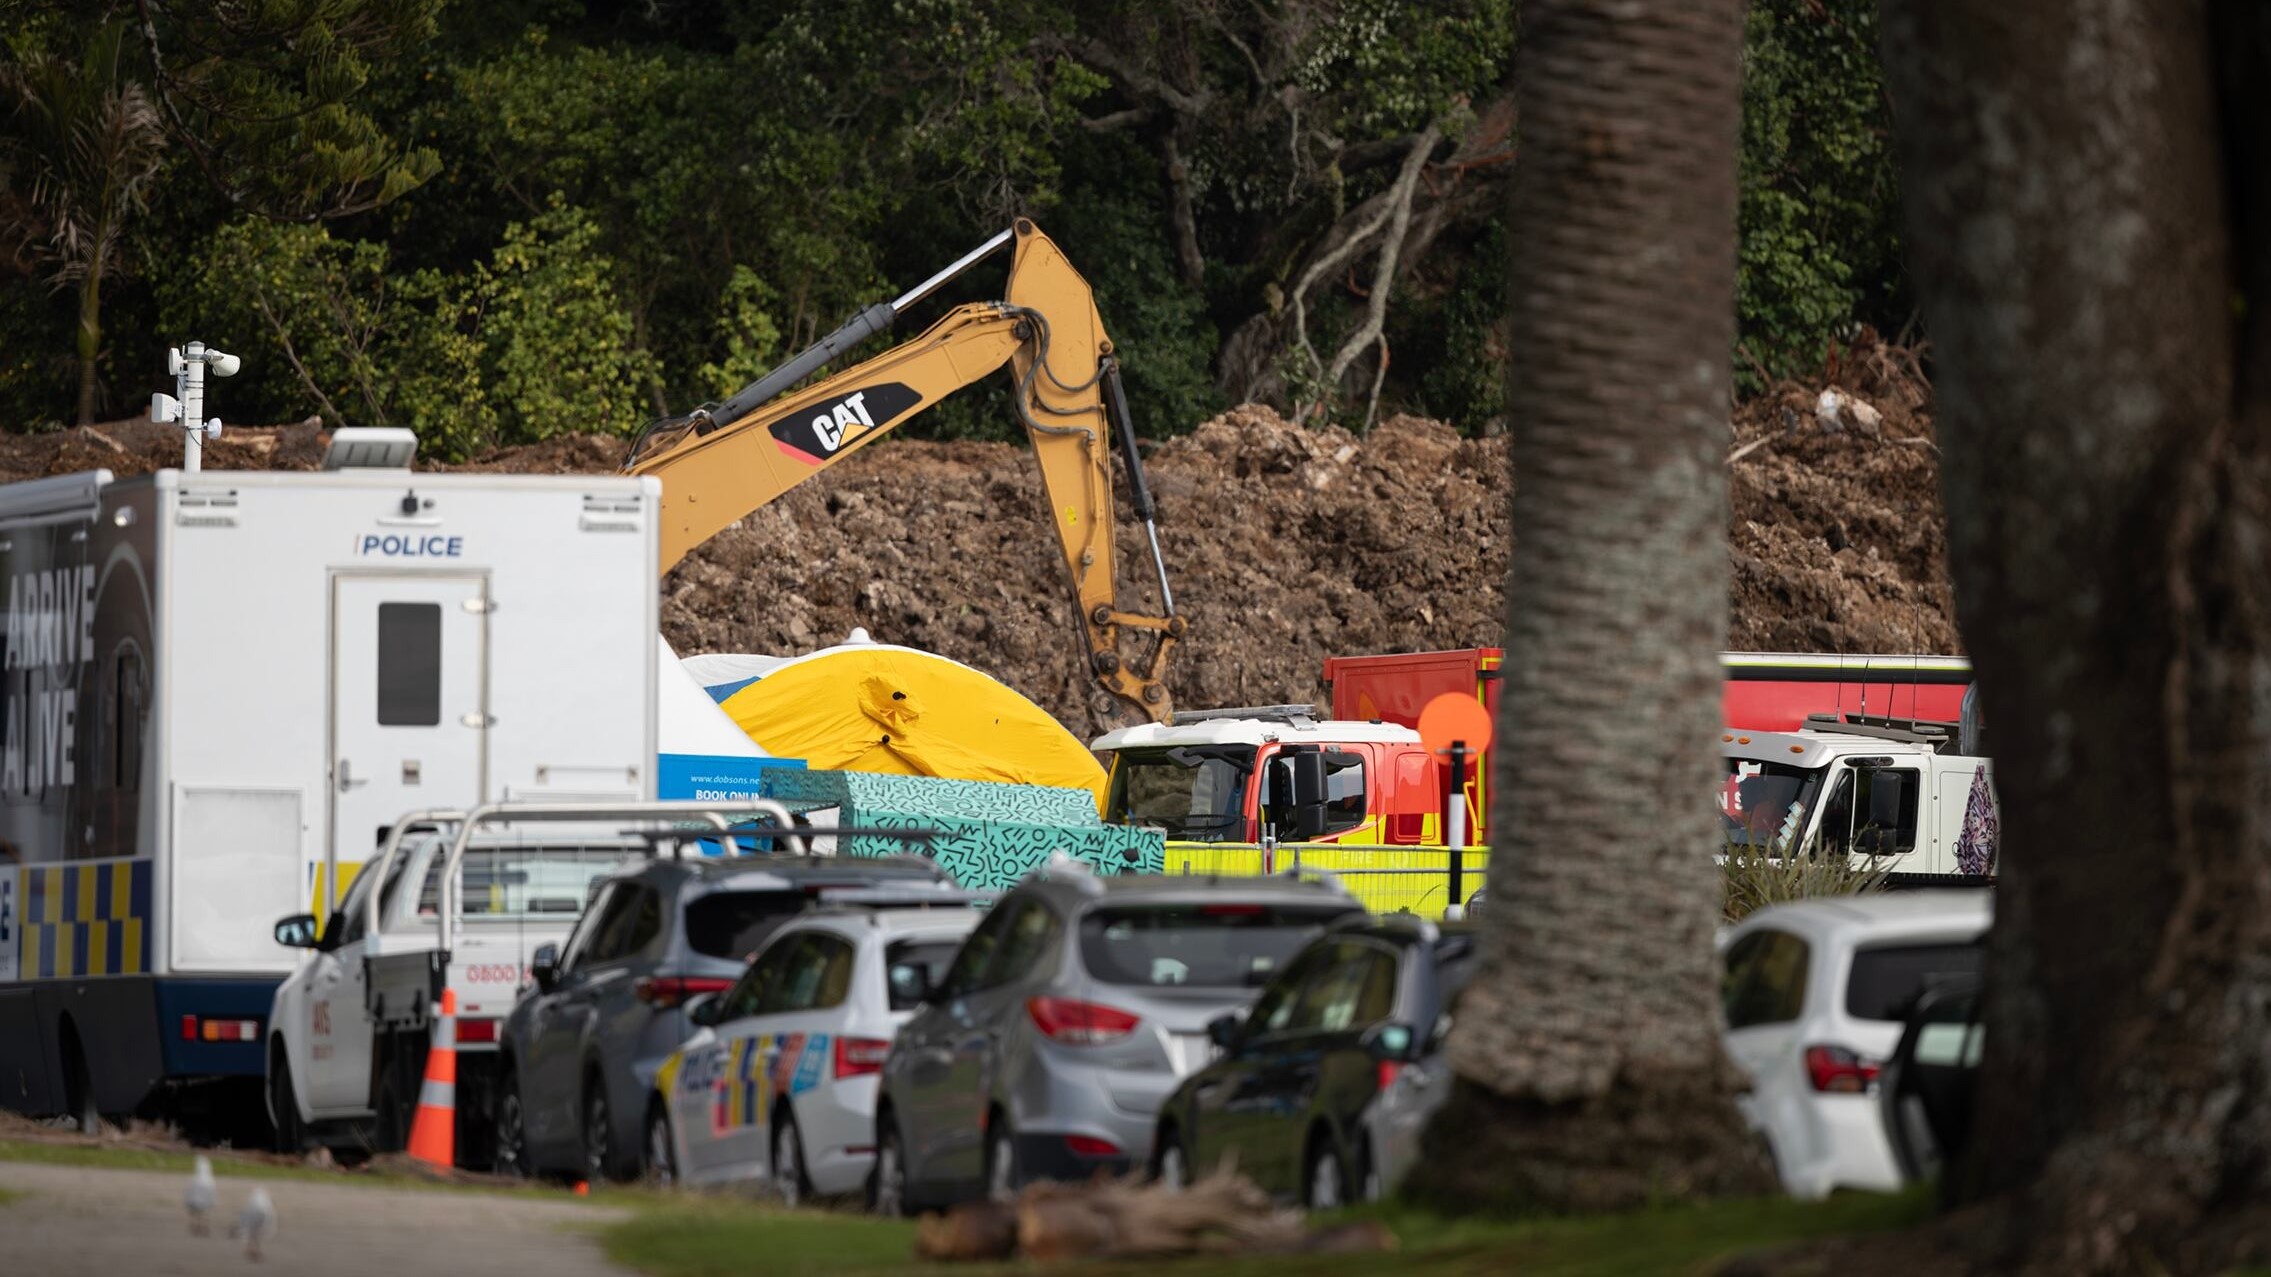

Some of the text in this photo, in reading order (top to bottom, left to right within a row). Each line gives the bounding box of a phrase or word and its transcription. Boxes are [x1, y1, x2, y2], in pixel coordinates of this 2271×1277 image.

[812, 391, 875, 451] CAT
[363, 535, 464, 556] POLICE
[5, 565, 95, 670] ARRIVE
[2, 688, 75, 790] ALIVE
[695, 789, 728, 801] BOOK
